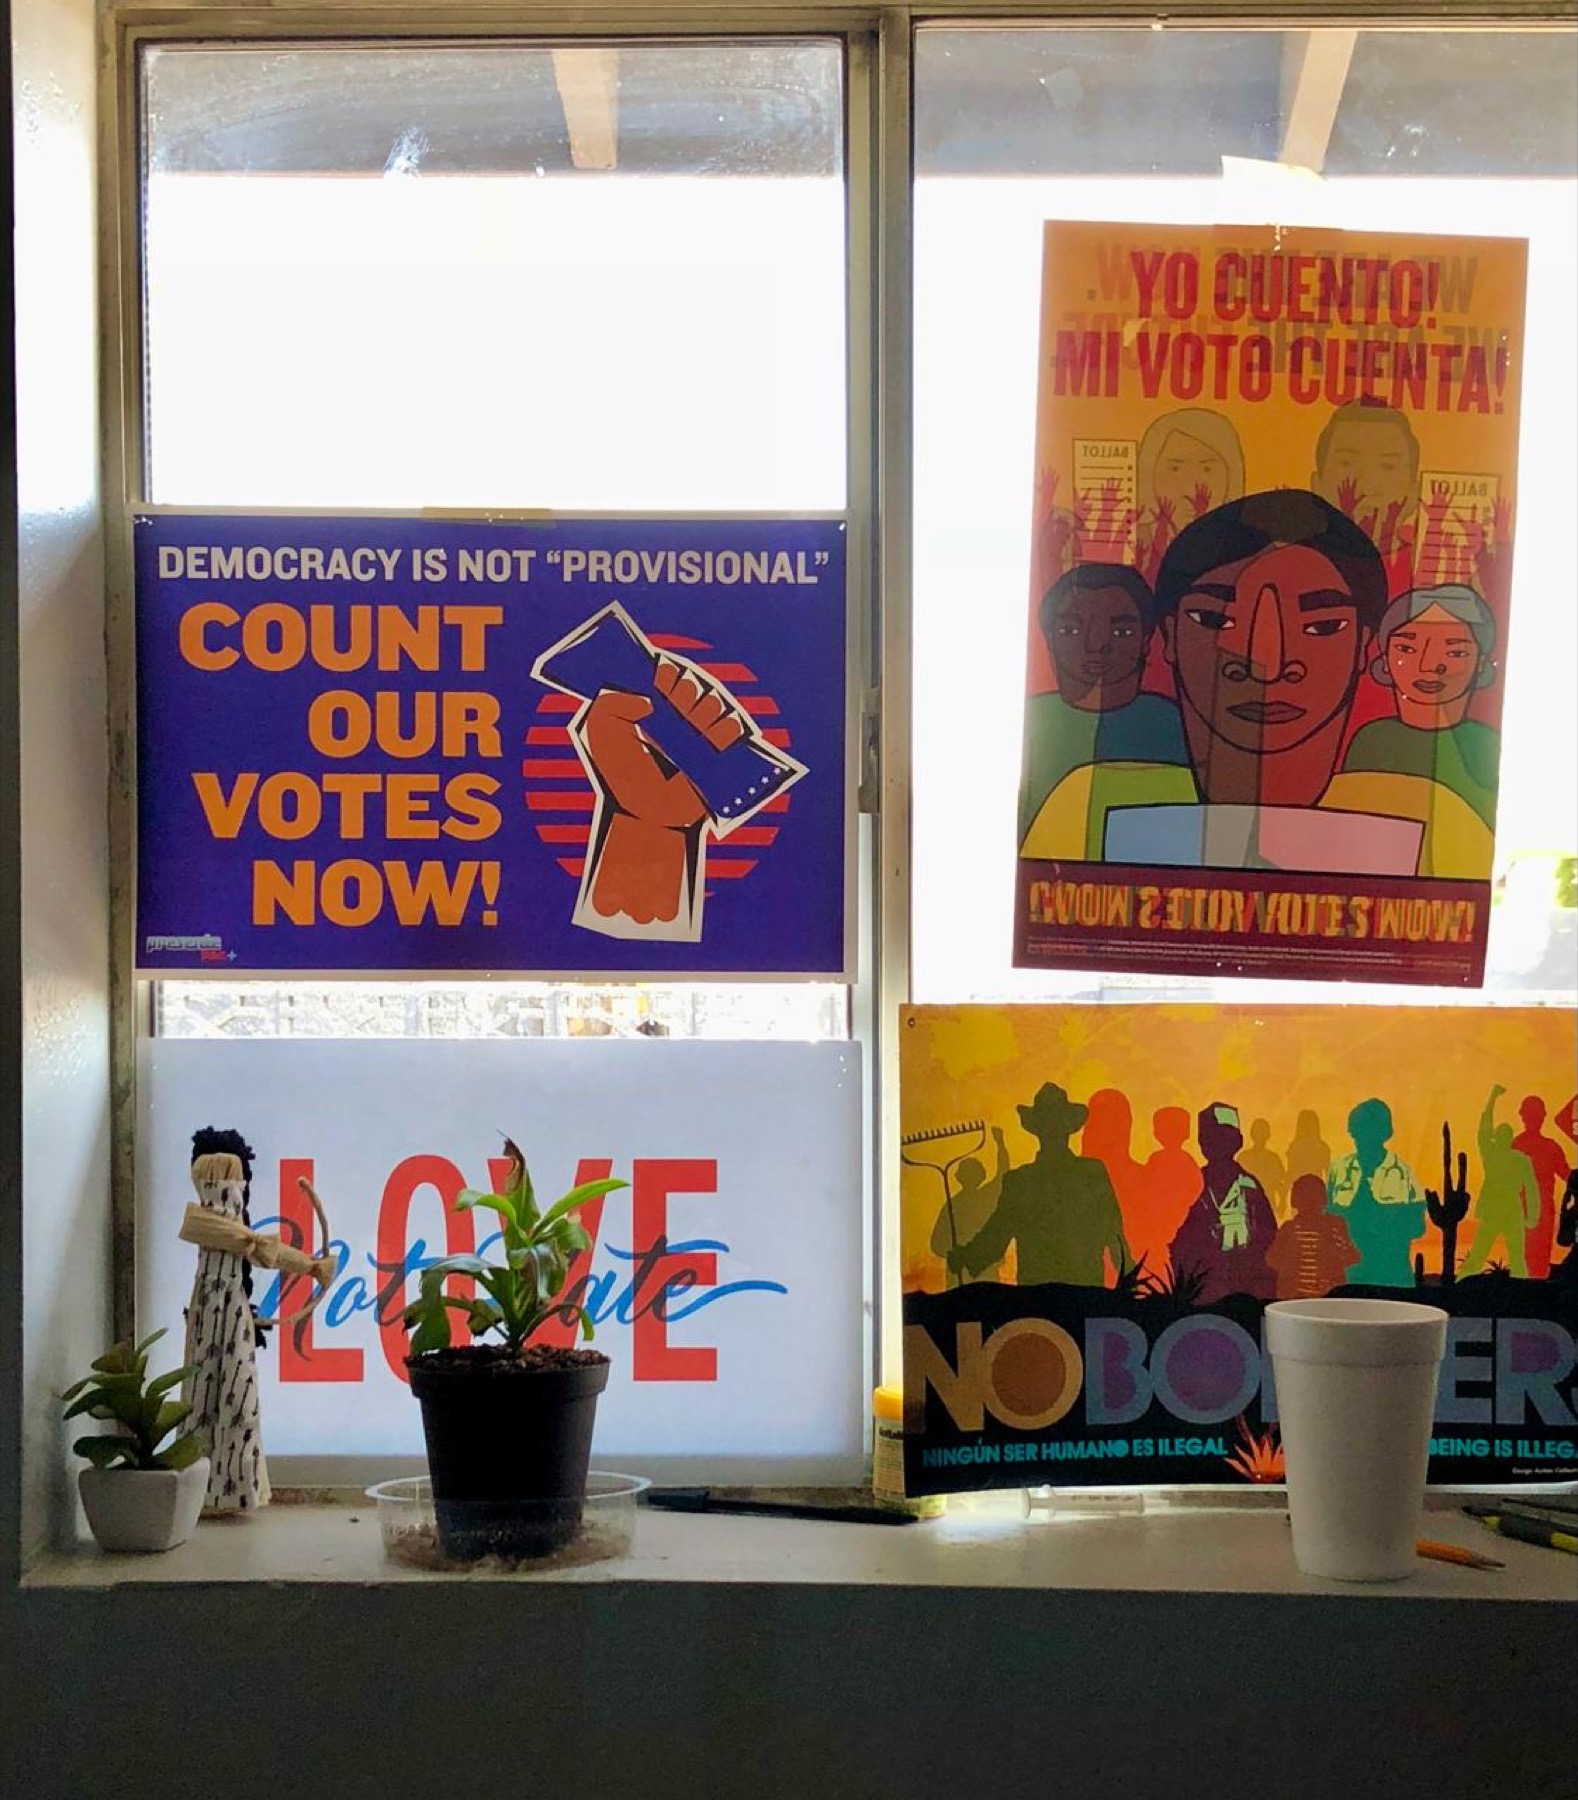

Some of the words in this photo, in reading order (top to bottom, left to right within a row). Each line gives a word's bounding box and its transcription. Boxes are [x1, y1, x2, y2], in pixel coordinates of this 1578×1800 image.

[1130, 251, 1199, 320] YO
[1214, 252, 1441, 330] CUENTO!
[1053, 330, 1121, 398] MI
[1136, 332, 1273, 402] VOTO
[1289, 336, 1508, 416] CUENTA!
[158, 546, 402, 580] DEMOCRACY
[412, 549, 448, 582] IS
[458, 550, 537, 583] NOT
[178, 602, 504, 673] COUNT
[307, 690, 503, 758] OUR
[191, 772, 503, 840] VOTES
[252, 859, 501, 928] NOW!
[922, 1438, 1000, 1468] NINGÚN
[1003, 1442, 1038, 1463] SER
[1041, 1439, 1129, 1460] HUMANO
[1132, 1438, 1154, 1457] ES
[1158, 1436, 1229, 1457] ILEGAL
[1494, 1438, 1513, 1458] IS
[1516, 1440, 1578, 1459] ILLEG
